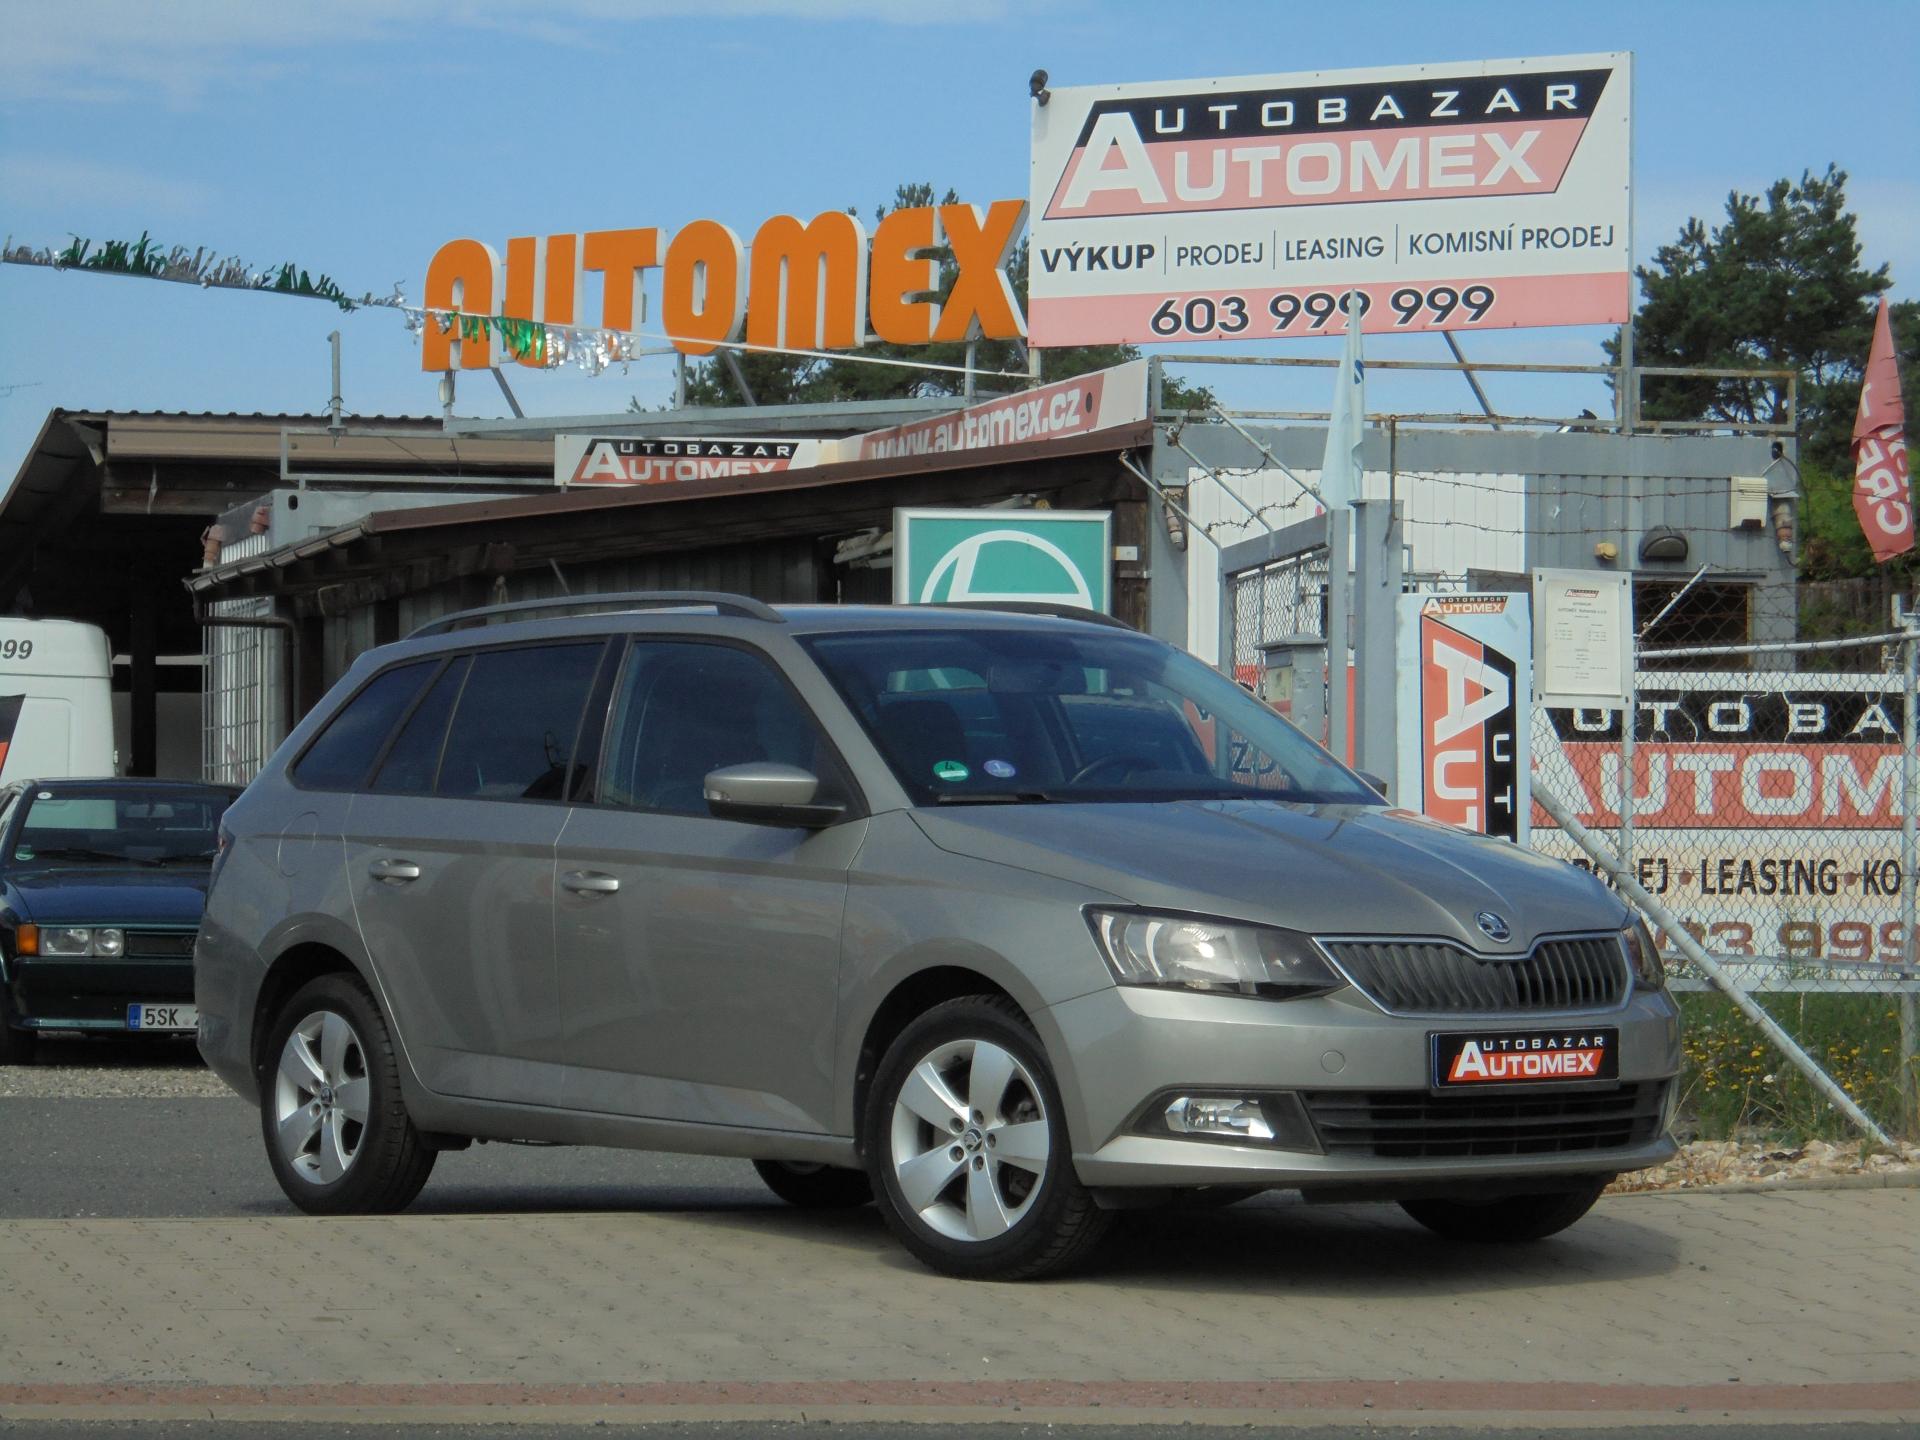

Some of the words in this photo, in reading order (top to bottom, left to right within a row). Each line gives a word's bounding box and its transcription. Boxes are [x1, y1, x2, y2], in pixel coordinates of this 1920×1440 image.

[1059, 111, 1542, 209] AUTOMEX
[1040, 241, 1155, 273] VÝKUP
[1176, 242, 1264, 267] PRODEJ
[1285, 236, 1384, 261] LEASING
[1409, 223, 1515, 256] KOMISNÍ
[1521, 225, 1614, 250] PRODEJ
[421, 199, 1027, 372] AUTOMEX
[1150, 296, 1250, 336] 603
[1269, 289, 1371, 331] 999
[1390, 284, 1495, 327] 999
[1423, 598, 1502, 614] AUTOMEX
[0, 639, 33, 660] 99
[1493, 734, 1511, 842] UT
[1700, 859, 1838, 896] LEASING
[1454, 1041, 1594, 1078] AUTOMEX
